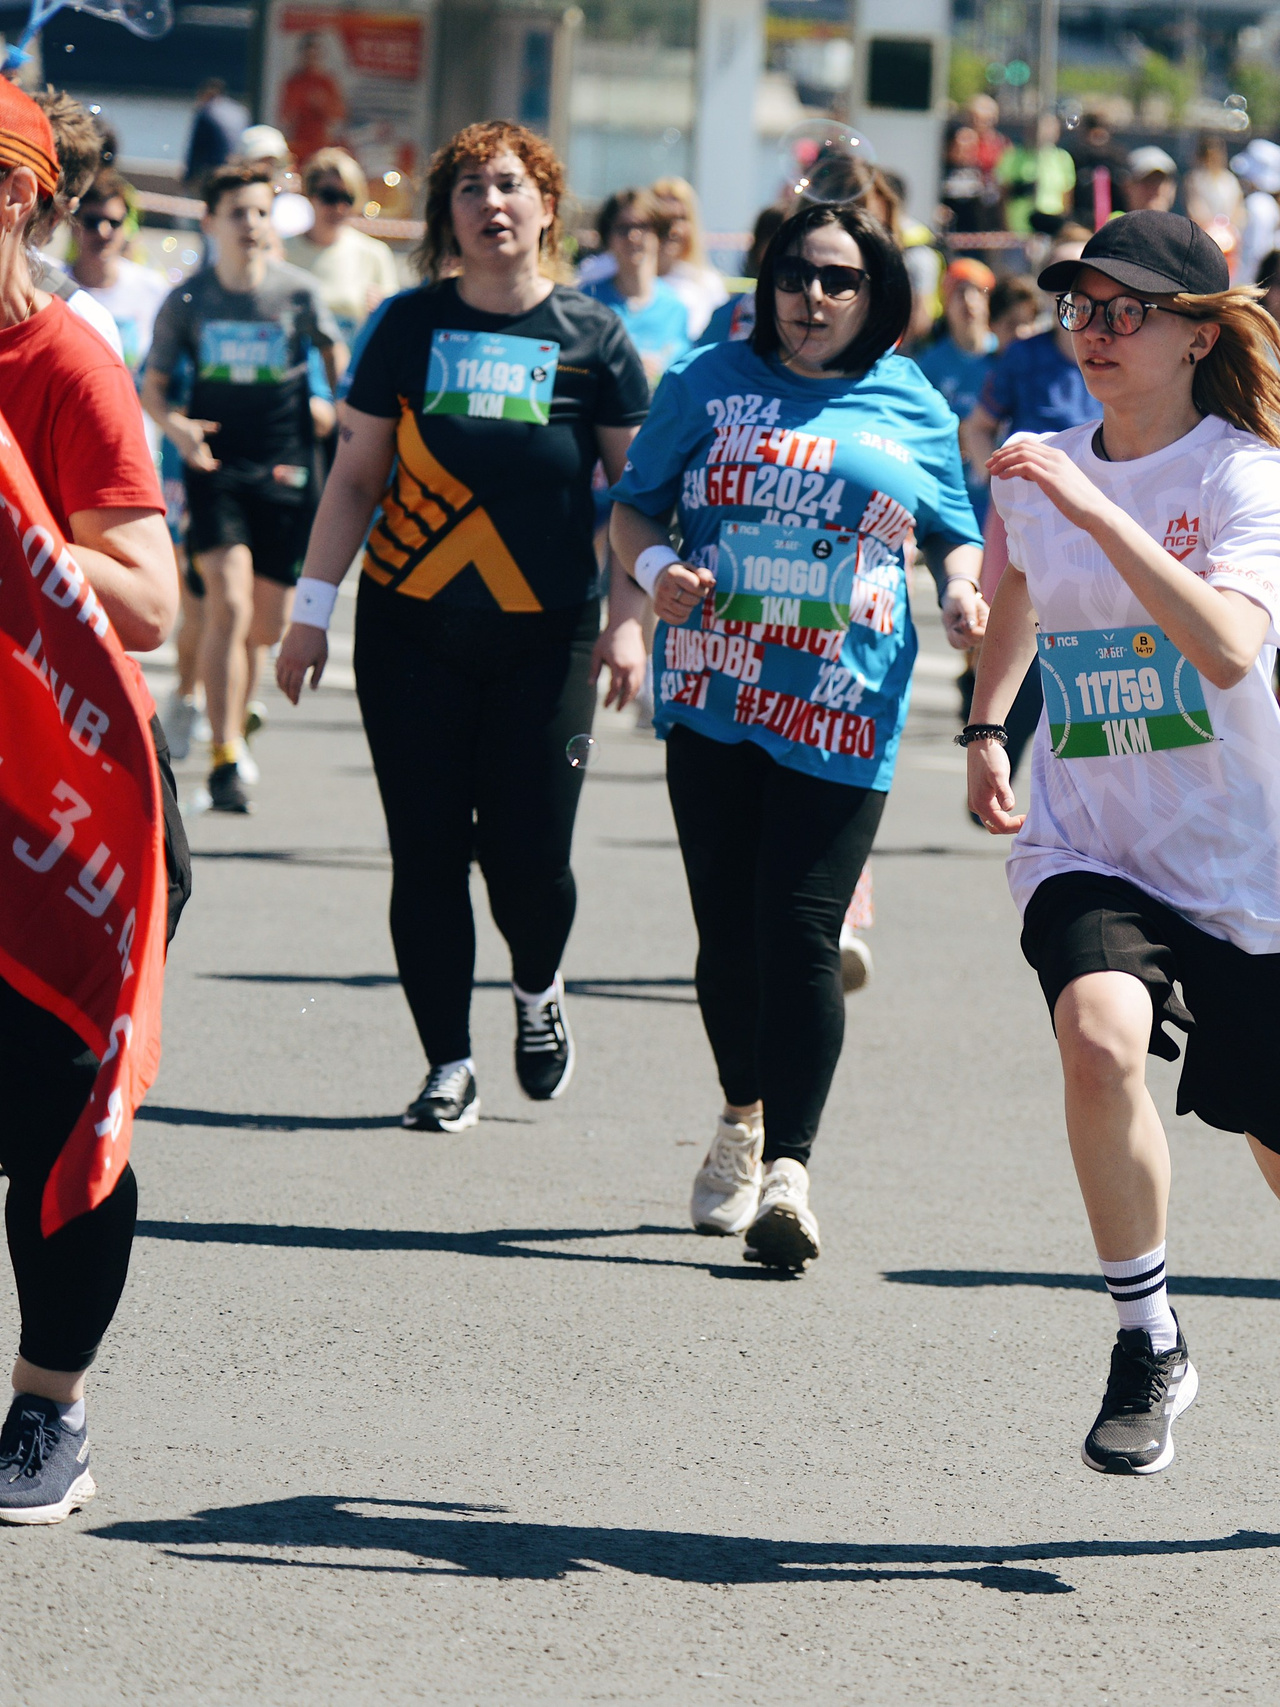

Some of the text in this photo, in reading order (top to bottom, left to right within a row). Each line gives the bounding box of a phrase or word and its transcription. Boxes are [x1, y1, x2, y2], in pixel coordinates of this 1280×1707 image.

[456, 358, 526, 393] 11493
[706, 394, 782, 428] 2024
[706, 425, 838, 475] #МЕЧТА
[1162, 534, 1198, 548] ПСБ
[742, 556, 828, 597] 10960
[1057, 636, 1078, 647] ПСБ
[1075, 667, 1164, 715] 11759
